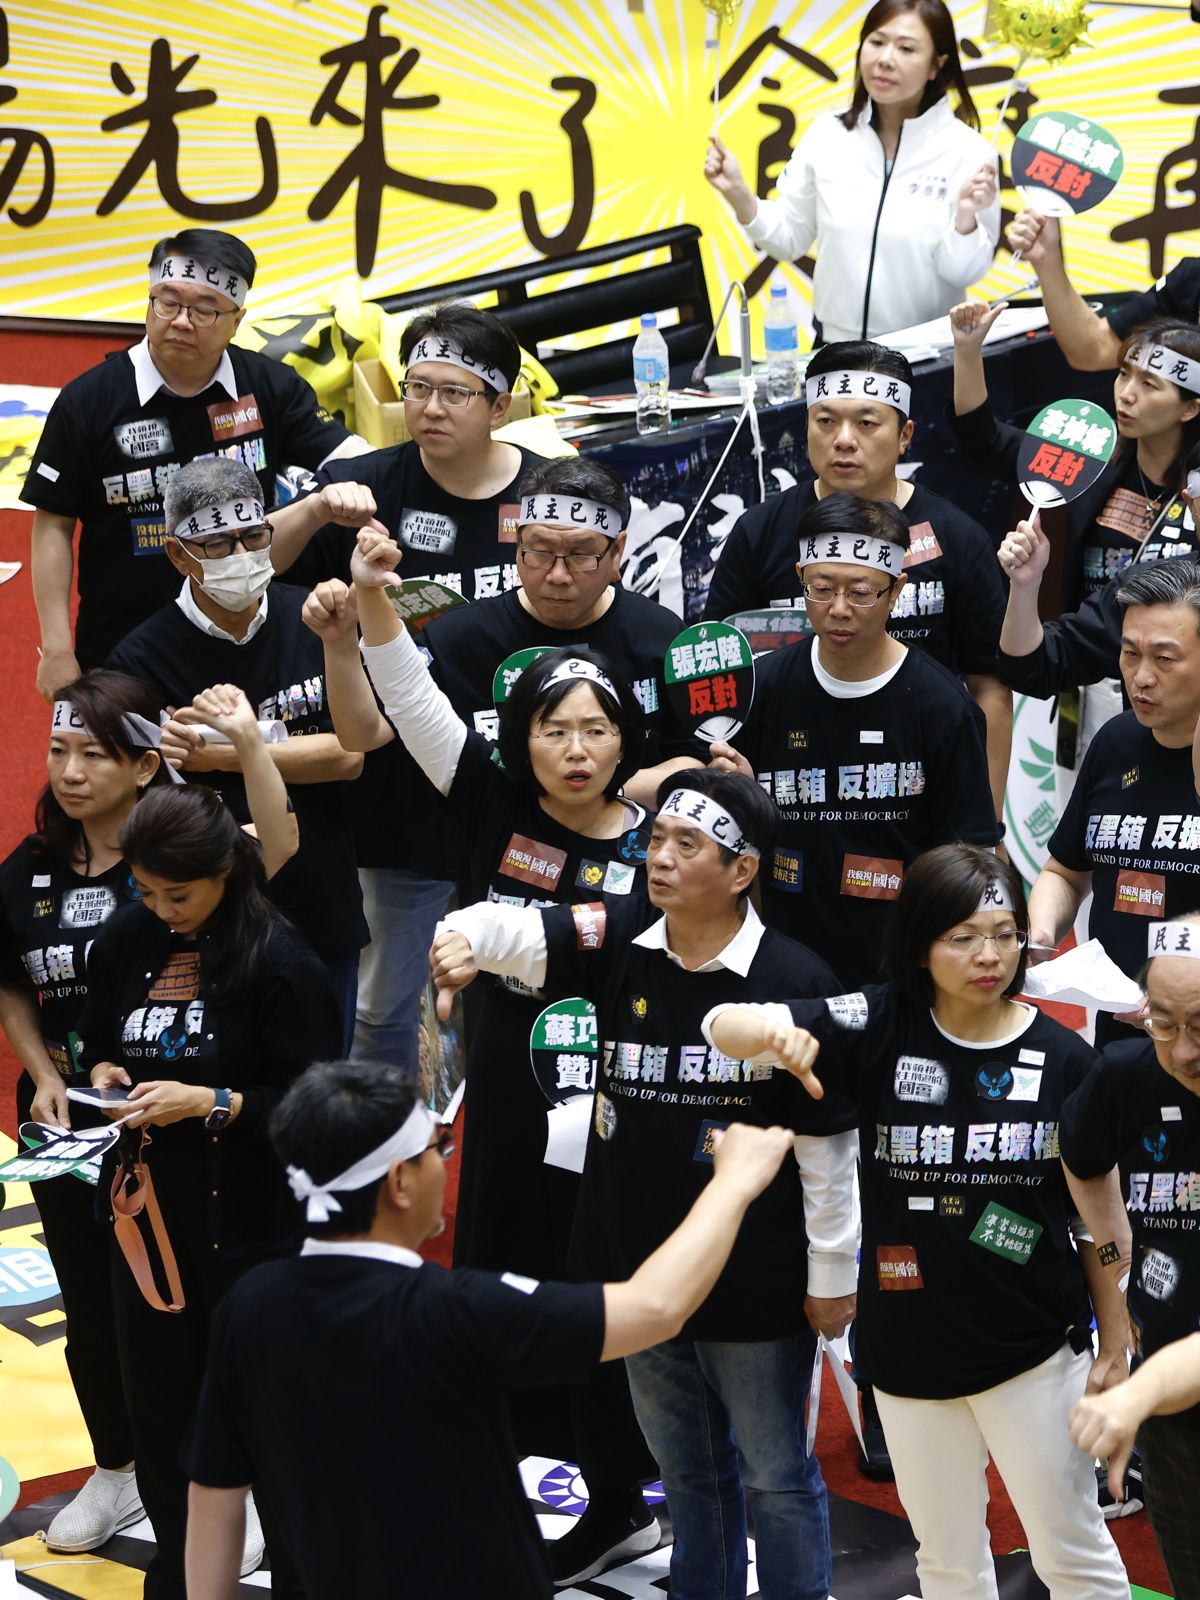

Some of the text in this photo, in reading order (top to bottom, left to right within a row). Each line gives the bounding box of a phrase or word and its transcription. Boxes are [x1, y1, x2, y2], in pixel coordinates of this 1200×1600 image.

[1025, 149, 1093, 199] 反對
[161, 260, 238, 297] 民主已死
[416, 339, 497, 381] 民主已死
[816, 374, 901, 403] 民主已死
[1029, 445, 1086, 486] 反對
[525, 497, 609, 530] 民主已死
[805, 536, 893, 567] 民主已死
[671, 633, 743, 680] 張宏陸
[688, 673, 738, 717] 反對
[837, 761, 926, 800] 反擴權
[665, 790, 749, 856] 民主已死
[802, 810, 817, 821] UP
[819, 810, 842, 821] FOR
[844, 809, 911, 821] DEMOCRACY
[1092, 853, 1116, 865] STAND
[1118, 856, 1131, 867] UP
[1133, 858, 1151, 869] FOR
[57, 986, 72, 997] UP
[609, 1081, 637, 1098] STAND
[640, 1087, 657, 1100] UP
[964, 1121, 1060, 1163] 反擴權
[889, 1166, 1044, 1187] STAND UP FOR DEMOCRACY
[1142, 1216, 1178, 1230] STAND
[1181, 1218, 1197, 1231] UP
